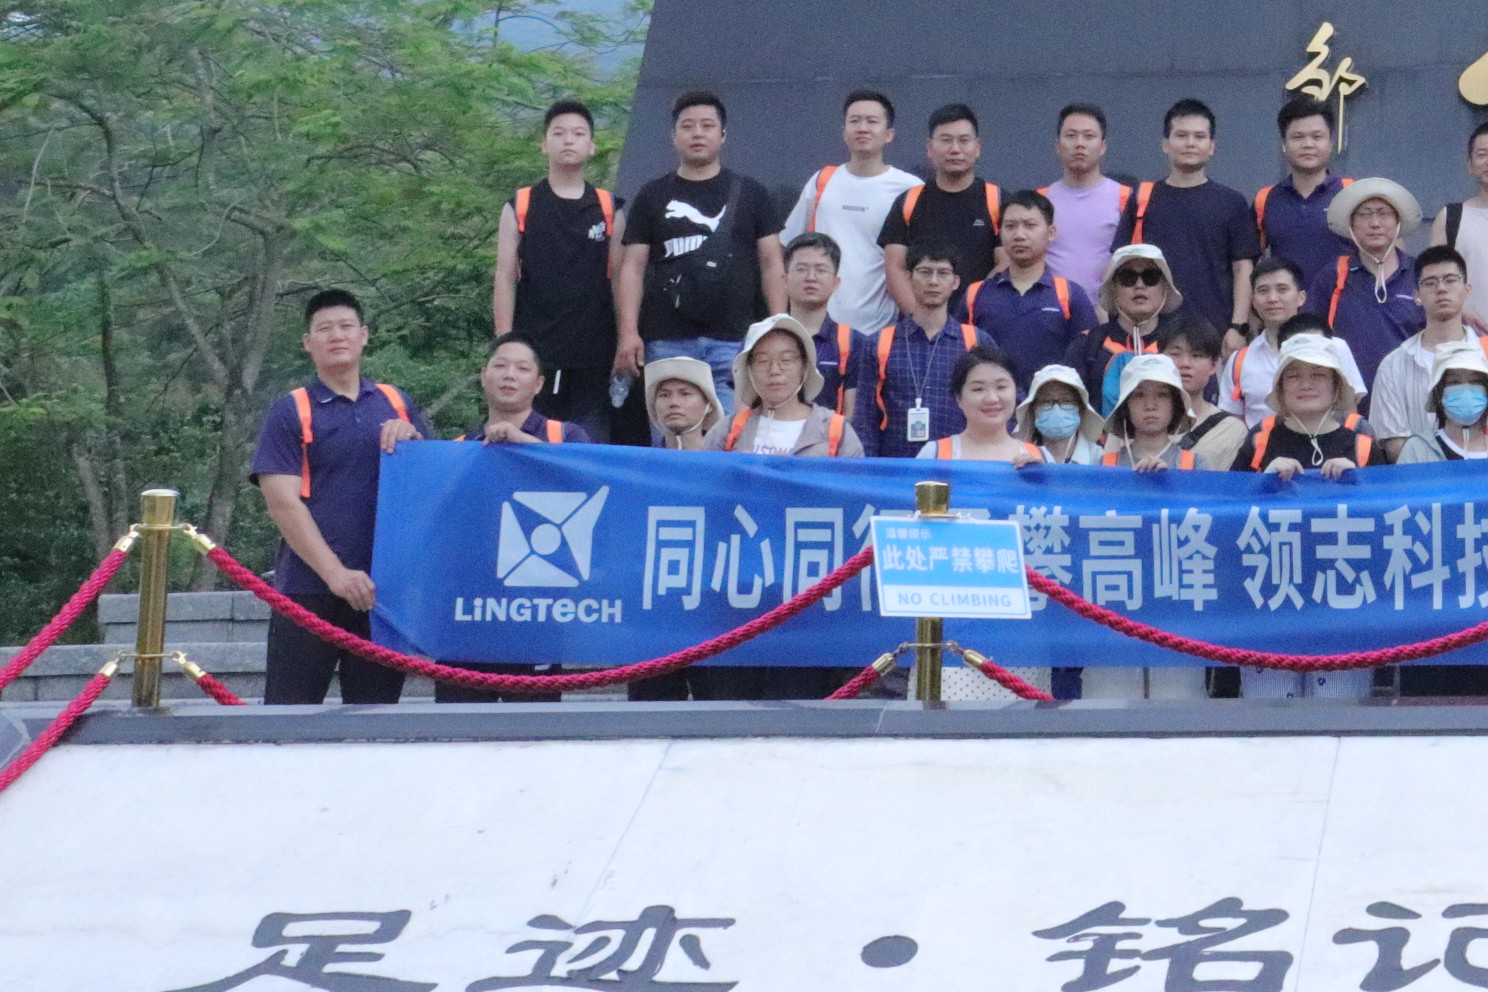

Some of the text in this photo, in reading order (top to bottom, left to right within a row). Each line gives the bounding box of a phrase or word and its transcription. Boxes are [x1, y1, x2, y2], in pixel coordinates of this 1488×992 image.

[663, 234, 709, 258] PUM
[882, 543, 1020, 575] 此处严禁攀爬
[898, 592, 1012, 608] NO CLIMBING
